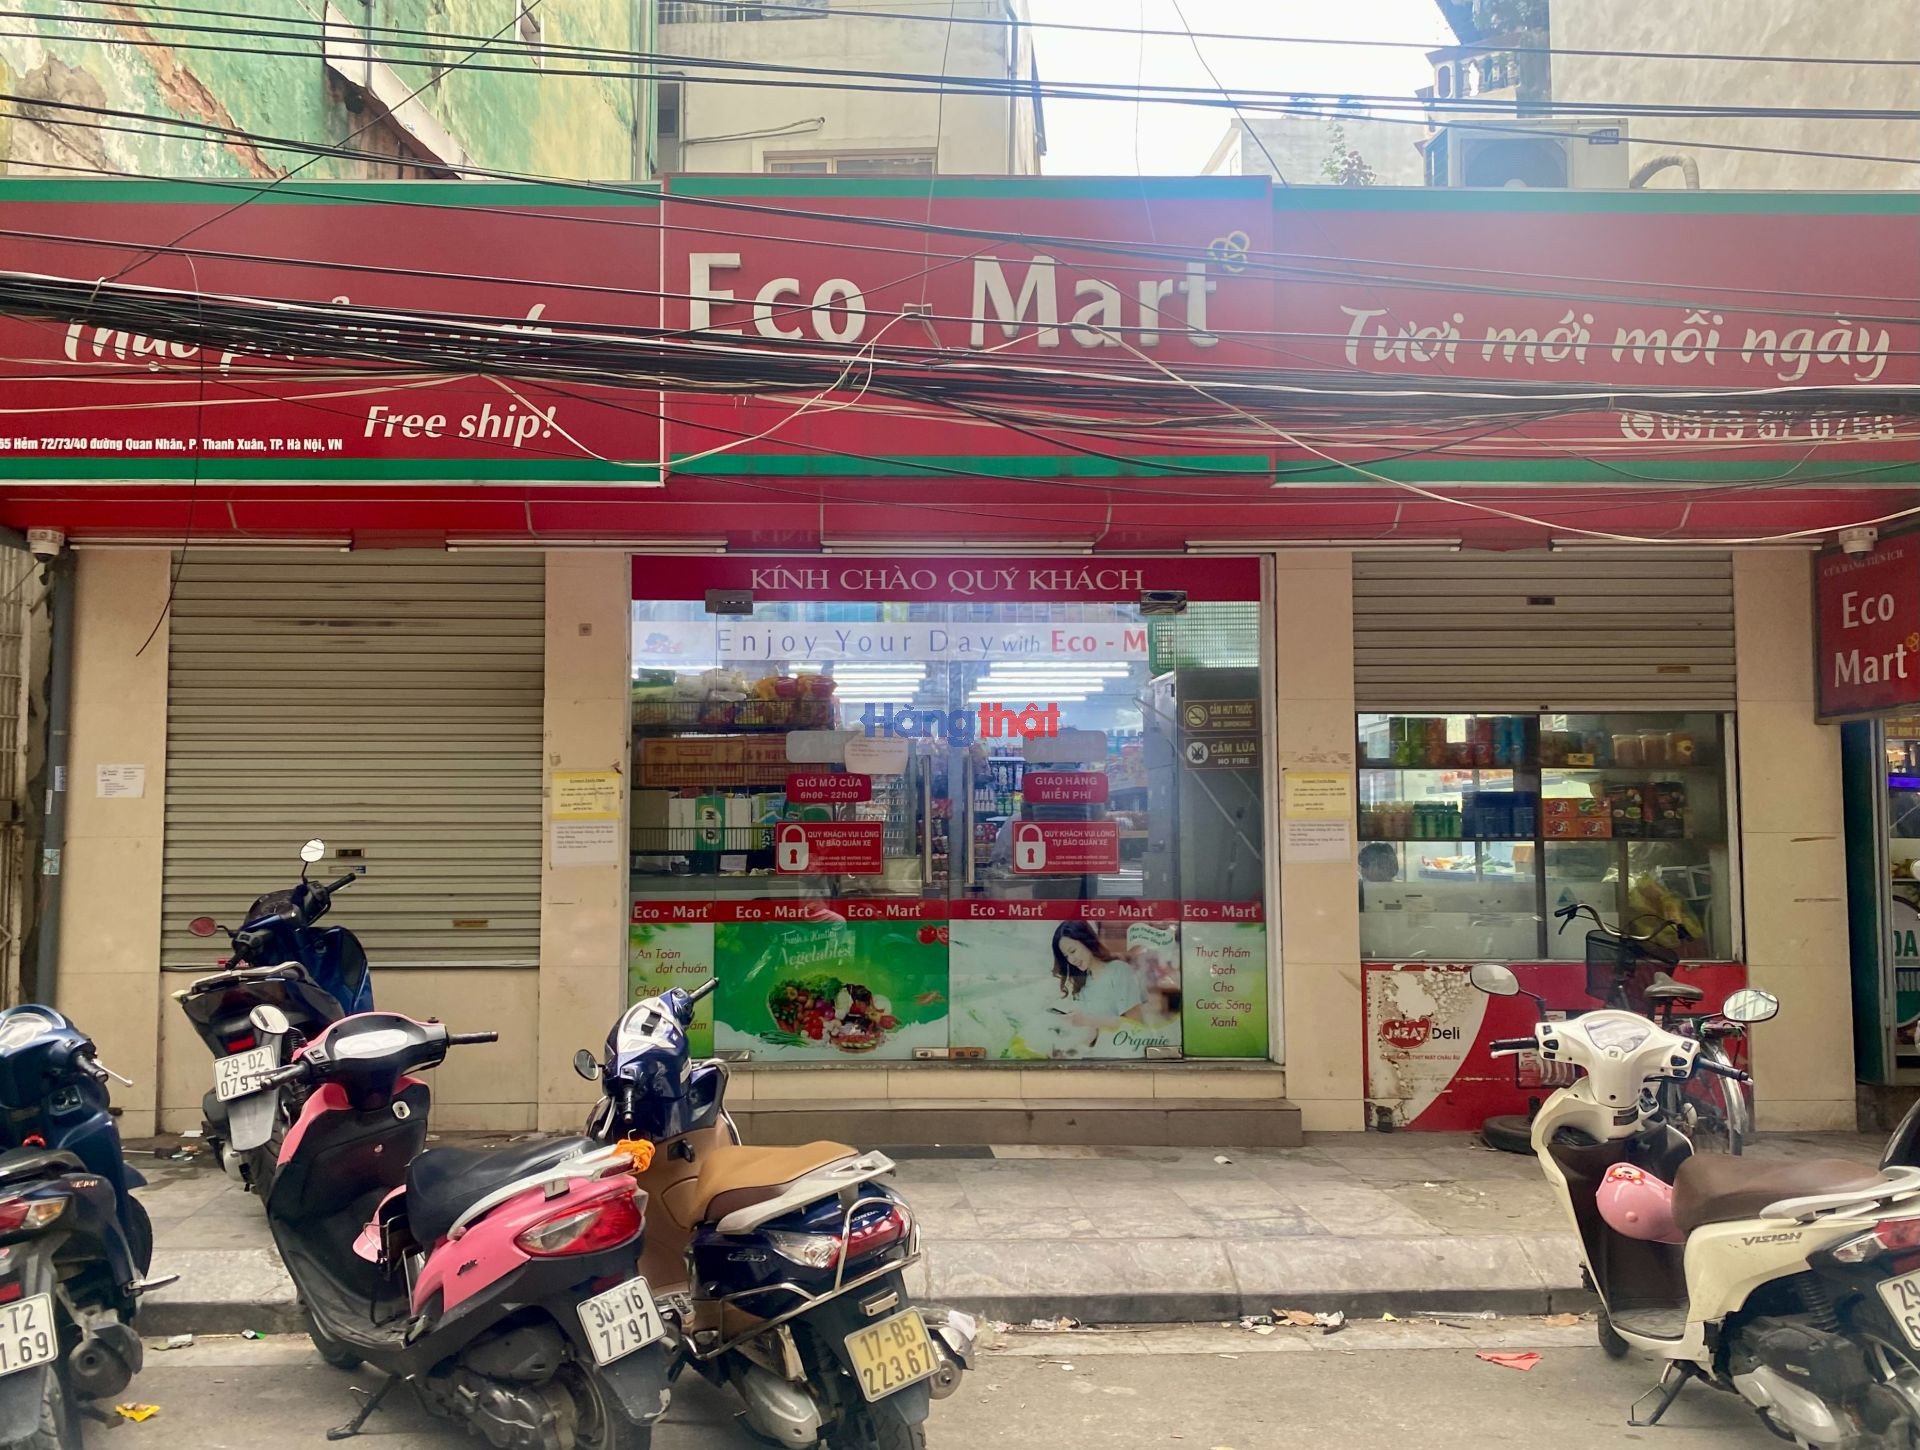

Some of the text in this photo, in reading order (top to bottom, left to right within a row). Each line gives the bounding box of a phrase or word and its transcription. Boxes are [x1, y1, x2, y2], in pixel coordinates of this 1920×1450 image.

[689, 252, 867, 345] Eco
[969, 255, 1220, 348] Mart
[1340, 305, 1890, 382] Tươi mới mỗi ngày
[364, 403, 557, 449] Free ship!
[41, 437, 88, 450] 72/73/40
[125, 438, 153, 450] Quan
[155, 437, 187, 451] Nhân,
[202, 438, 235, 450] Thanh
[237, 437, 267, 451] Xuân,
[270, 438, 285, 450] TP.
[287, 437, 302, 450] Hà
[304, 437, 325, 452] Nội,
[327, 438, 343, 450] VN
[750, 564, 1145, 596] KÍNH CHÀO QUÝ KHÁCH
[1842, 590, 1896, 629] Eco
[717, 629, 818, 660] Enjoy
[835, 629, 912, 653] Your
[929, 630, 995, 660] Day
[1002, 634, 1041, 653] with
[1051, 630, 1097, 653] Eco
[1834, 643, 1908, 688] Mart
[1217, 757, 1250, 765] NO FIRE
[1035, 776, 1063, 786] GIAO
[800, 791, 823, 799] 6h00
[830, 791, 859, 799] 22h00
[633, 905, 660, 919] Eco
[672, 905, 709, 919] Mart
[736, 906, 762, 919] Eco
[774, 905, 810, 919] Mart
[847, 904, 873, 918] Eco
[885, 904, 921, 918] Mart
[970, 904, 996, 917] Eco
[1008, 903, 1044, 917] Mart
[1080, 904, 1106, 917] Eco
[1118, 904, 1154, 918] Mart
[1183, 904, 1209, 918] Eco
[1221, 904, 1257, 918] Mart
[636, 948, 681, 959] An Toàn
[1212, 981, 1235, 993] Cho
[1210, 1015, 1238, 1028] Xanh
[1112, 1029, 1170, 1051] Organic
[1431, 1026, 1460, 1040] Deli
[222, 1052, 266, 1078] 29-D2
[1741, 1231, 1803, 1247] VISION
[599, 1311, 652, 1358] 7797
[859, 1317, 916, 1361] 17-B5
[863, 1342, 931, 1396] 223.67
